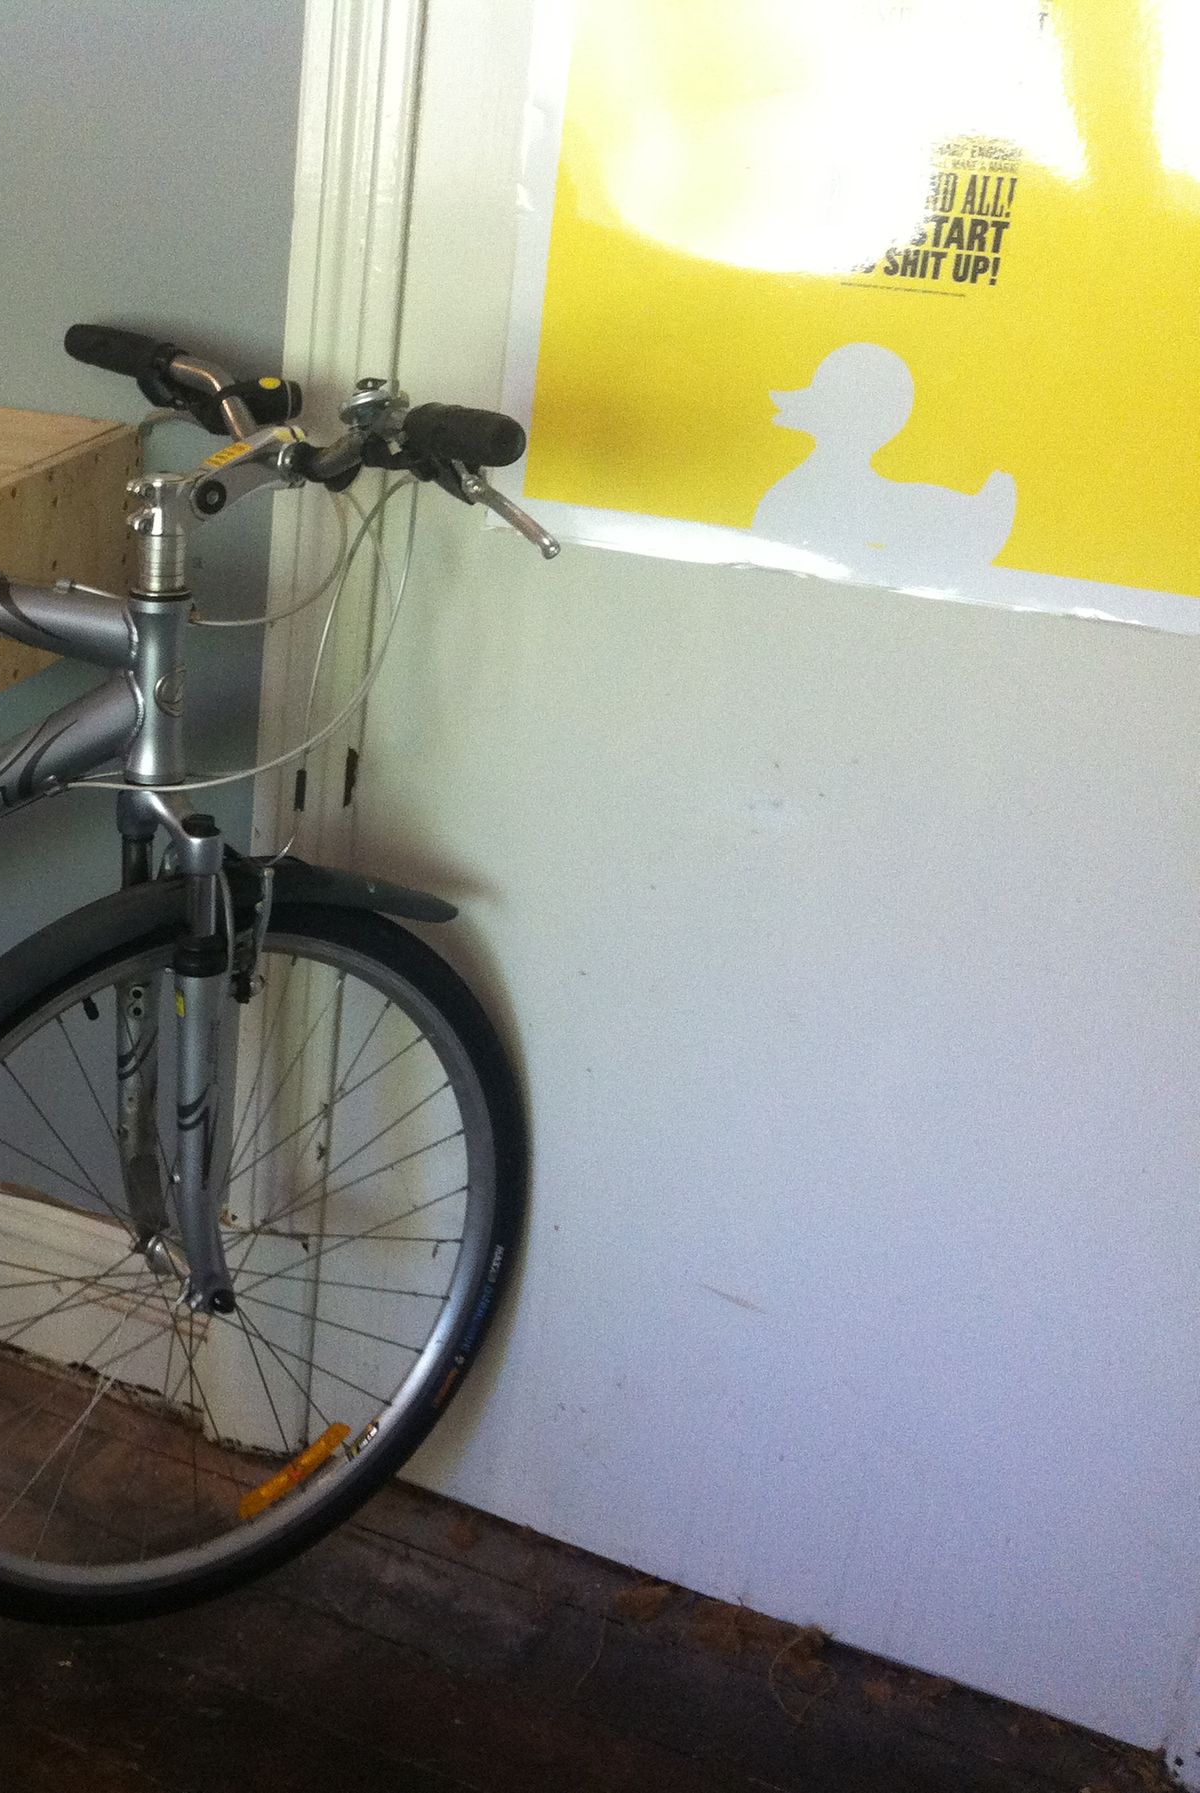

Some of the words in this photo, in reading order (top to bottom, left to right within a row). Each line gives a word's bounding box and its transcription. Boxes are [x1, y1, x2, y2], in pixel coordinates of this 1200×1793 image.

[962, 174, 1018, 218] ALL!
[883, 246, 949, 281] SHIT
[952, 253, 1001, 286] UP!
